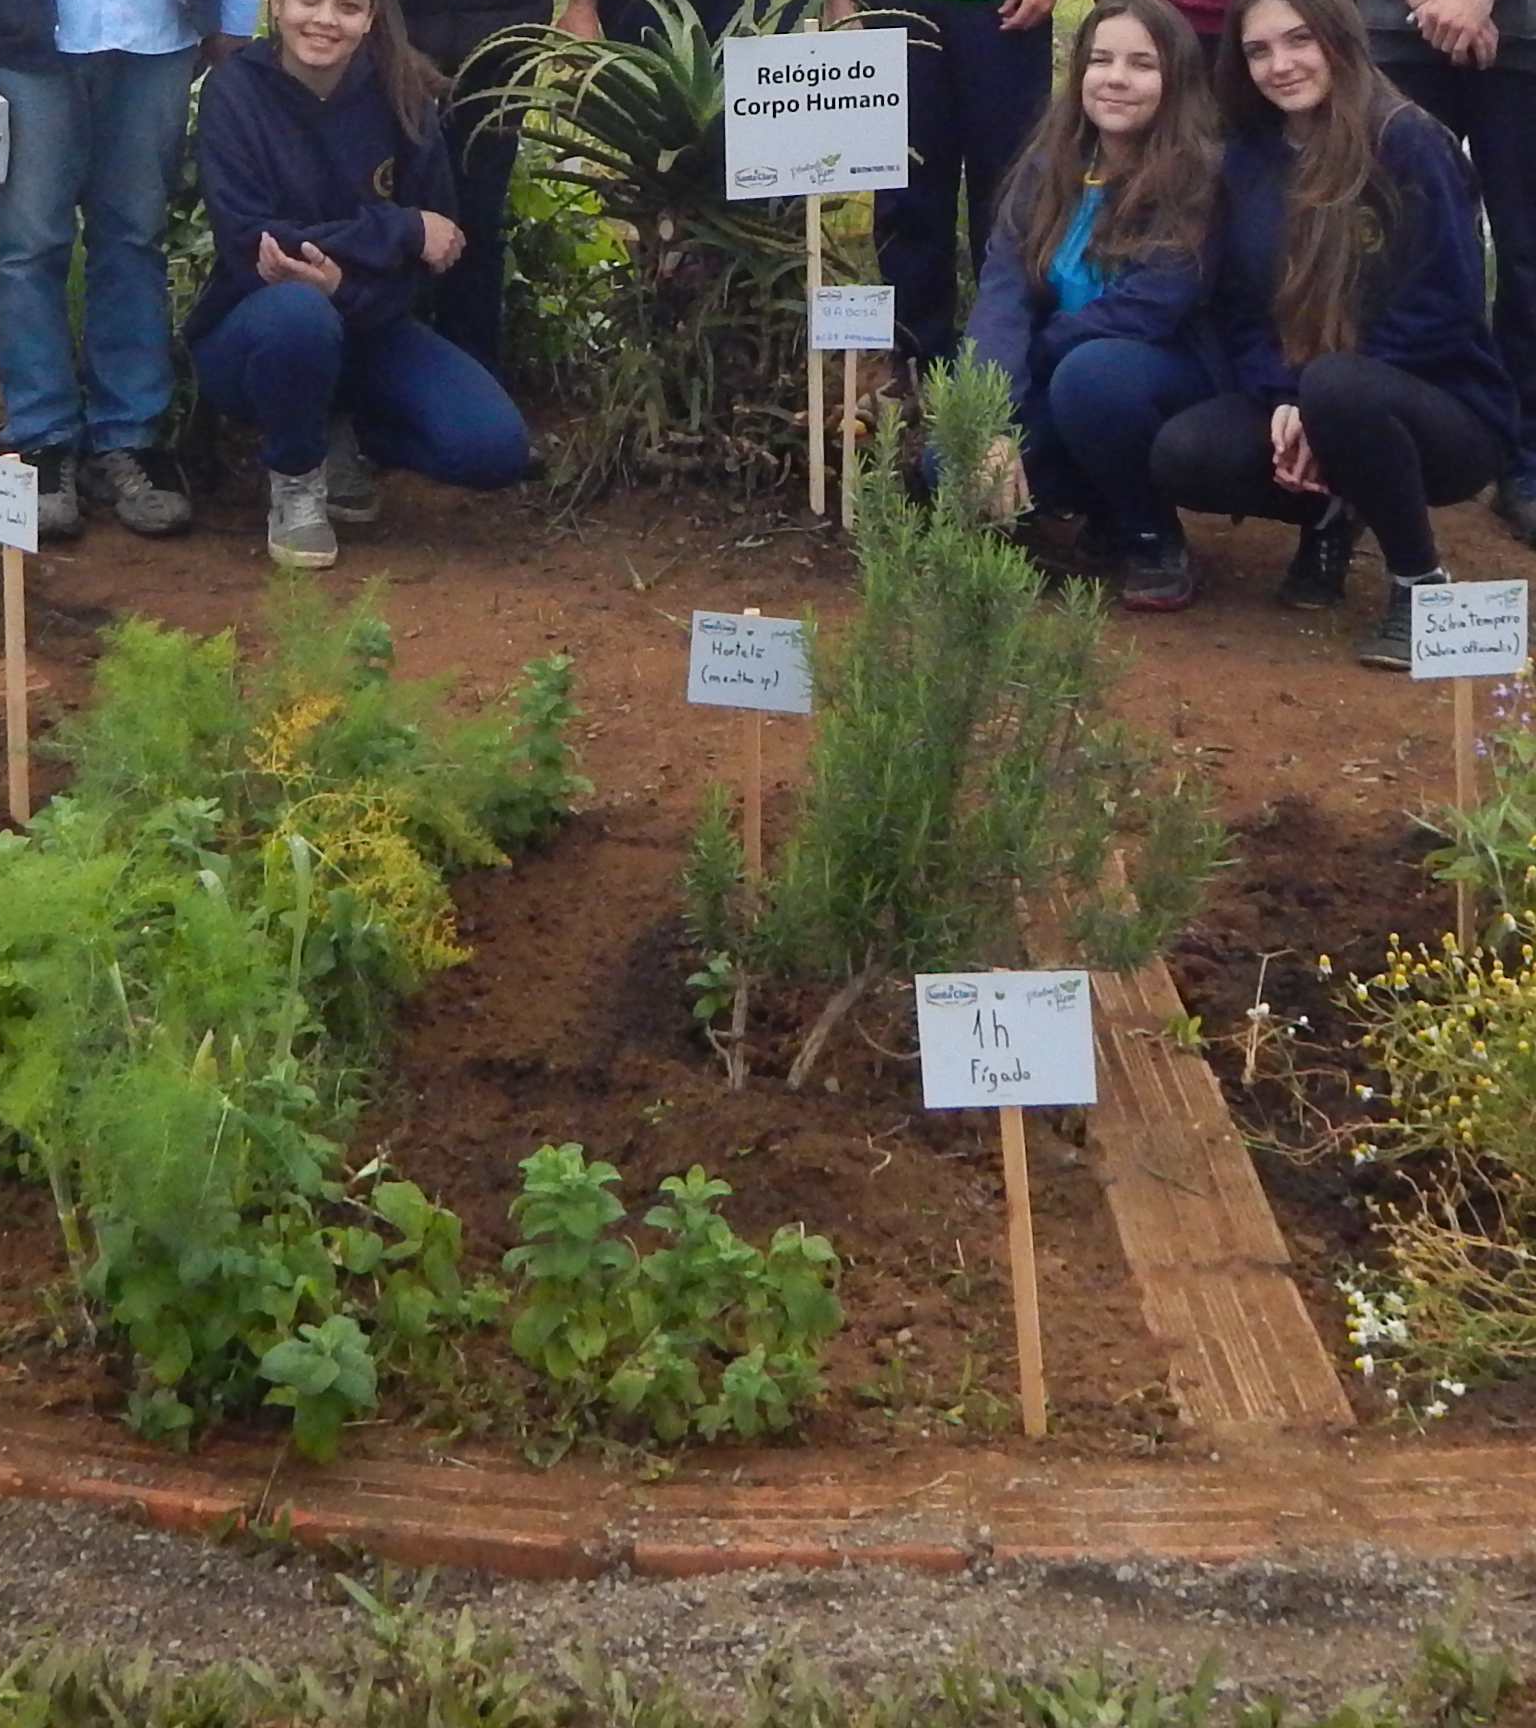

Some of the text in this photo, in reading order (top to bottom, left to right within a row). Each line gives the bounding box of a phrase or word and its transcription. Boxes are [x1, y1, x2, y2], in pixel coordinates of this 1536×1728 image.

[757, 60, 875, 86] Relógio do
[733, 92, 900, 118] Corpo Humano
[971, 1058, 1031, 1092] Fígado
